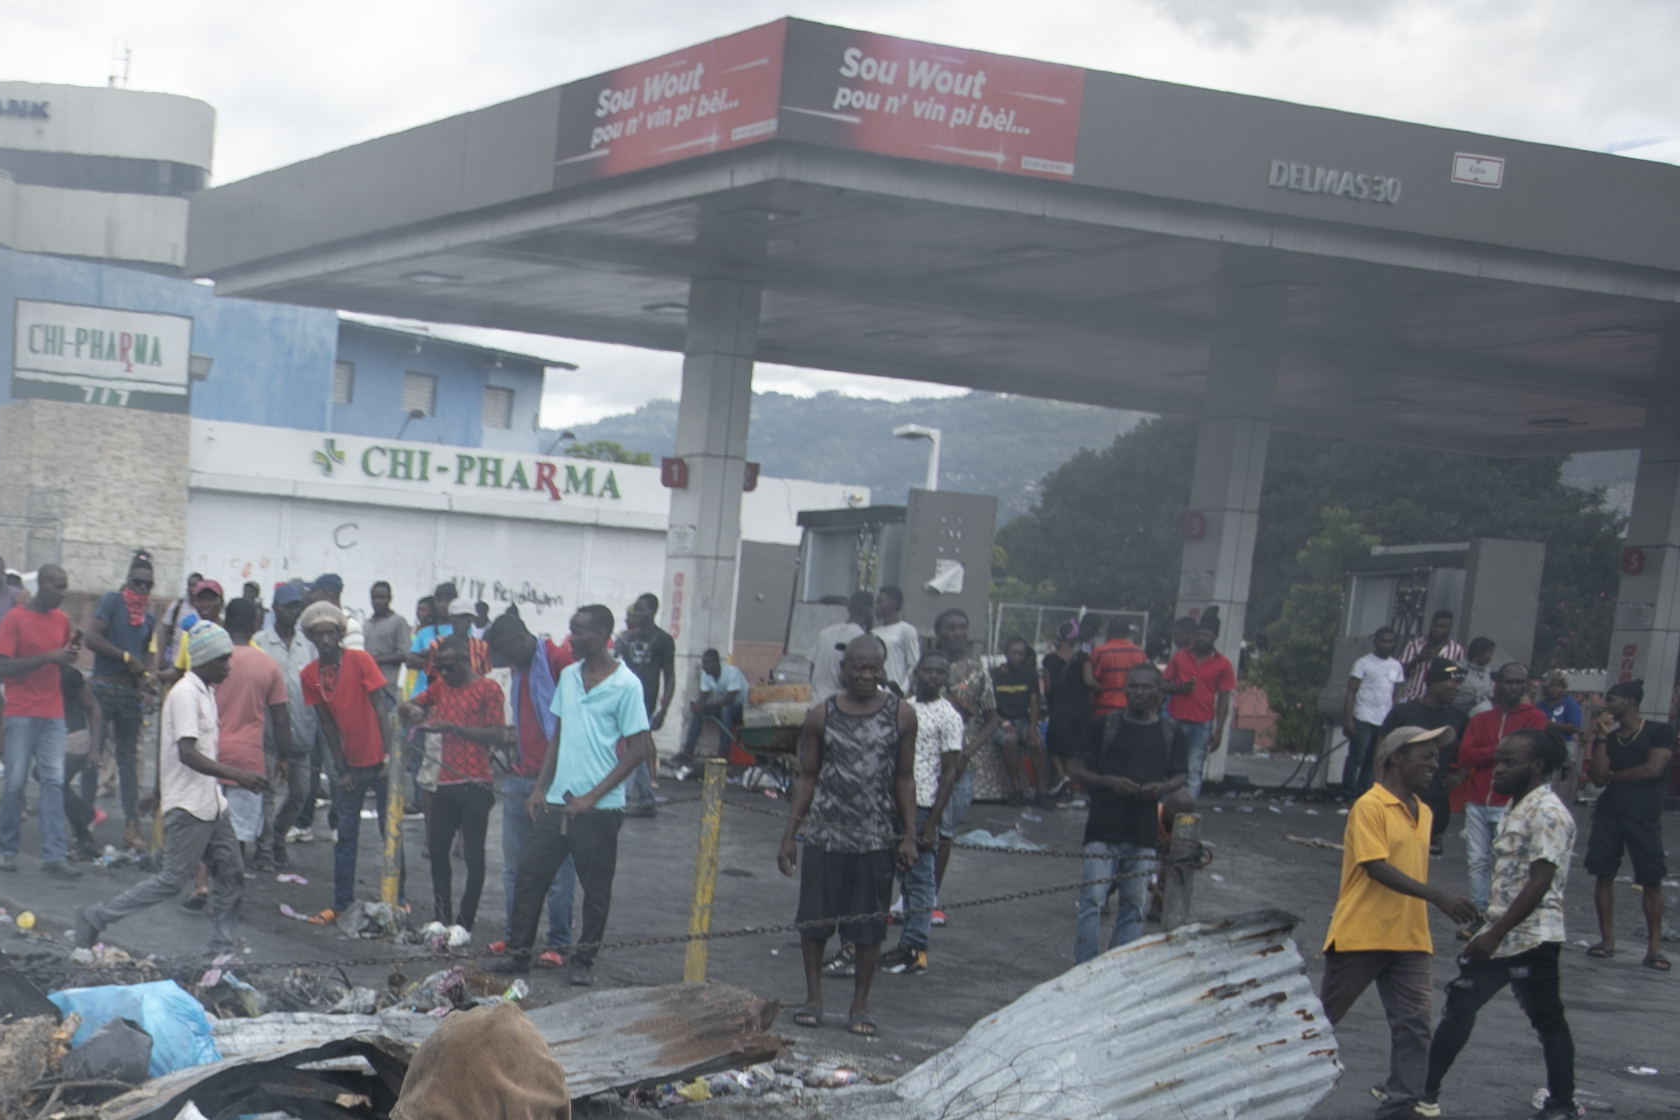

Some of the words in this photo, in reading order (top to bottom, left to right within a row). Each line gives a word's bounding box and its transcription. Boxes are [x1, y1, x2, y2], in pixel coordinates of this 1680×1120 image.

[594, 86, 638, 118] Sou
[643, 62, 705, 105] Wout
[839, 47, 898, 85] Sou
[908, 58, 987, 100] Wout
[590, 121, 623, 149] pou
[646, 103, 671, 129] vin
[674, 96, 697, 127] pi
[833, 86, 880, 111] pou
[913, 97, 945, 122] vin
[949, 104, 977, 129] pi
[978, 106, 1031, 135] bèl...
[1268, 160, 1369, 200] DELMAS
[1373, 175, 1402, 204] 30
[28, 323, 163, 374] CHI-PHARMA
[361, 445, 622, 501] CHI-PHARMA
[670, 463, 679, 482] 1
[1630, 553, 1639, 570] 5
